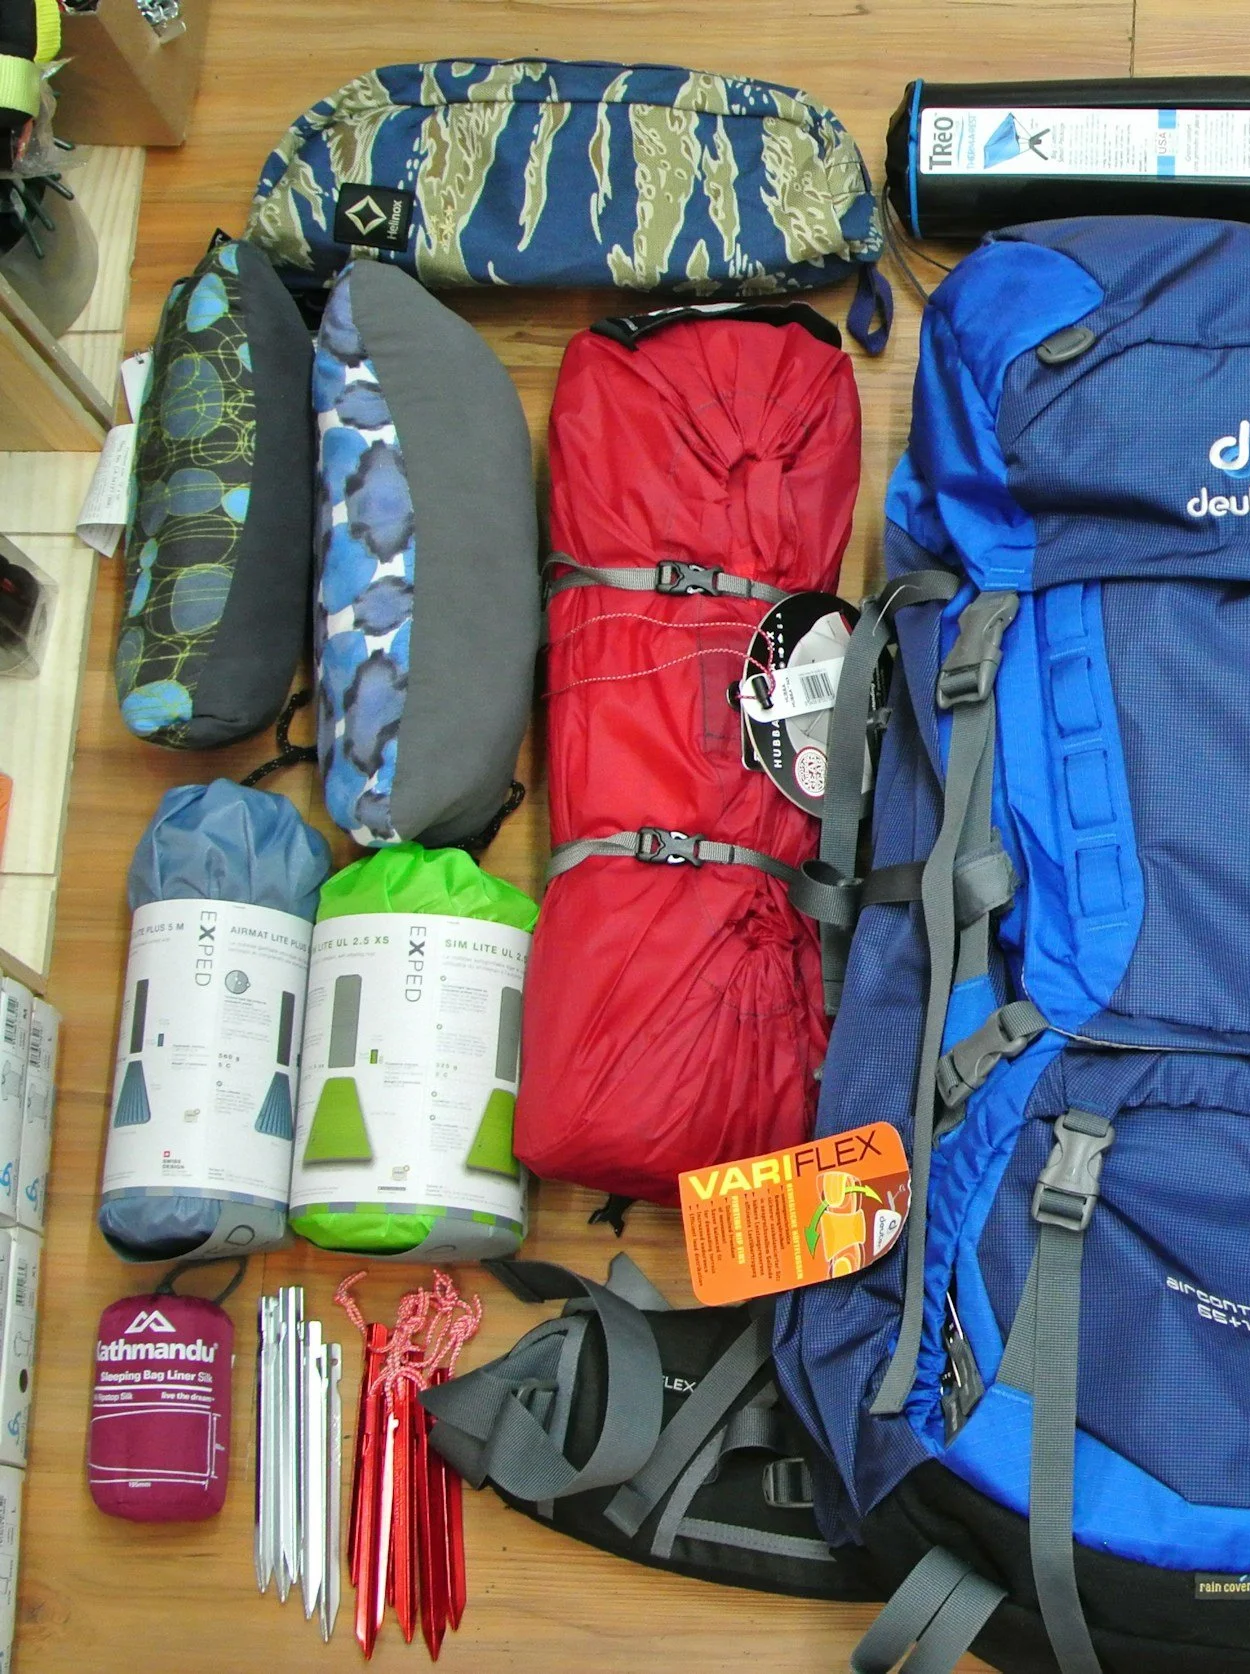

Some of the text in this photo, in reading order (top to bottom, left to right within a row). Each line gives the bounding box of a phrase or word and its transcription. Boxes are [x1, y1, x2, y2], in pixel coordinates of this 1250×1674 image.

[1158, 132, 1167, 154] USA
[387, 200, 402, 239] Helinox
[773, 720, 783, 769] HUBBA
[147, 924, 165, 934] PLUS
[176, 922, 184, 930] M
[230, 926, 308, 951] AIRMAT LITE PLUS
[195, 910, 217, 987] EXPED
[336, 939, 348, 947] UL
[353, 937, 370, 946] 2.5
[374, 936, 389, 944] XS
[445, 939, 468, 949] SIM
[472, 943, 497, 954] LITE
[501, 949, 513, 958] UL
[405, 926, 427, 1002] EXPED
[688, 1130, 882, 1201] VARIFLEX
[100, 1371, 141, 1383] Sleeping
[143, 1370, 164, 1382] Bag
[167, 1370, 196, 1381] Liner
[1200, 1581, 1221, 1592] rain
